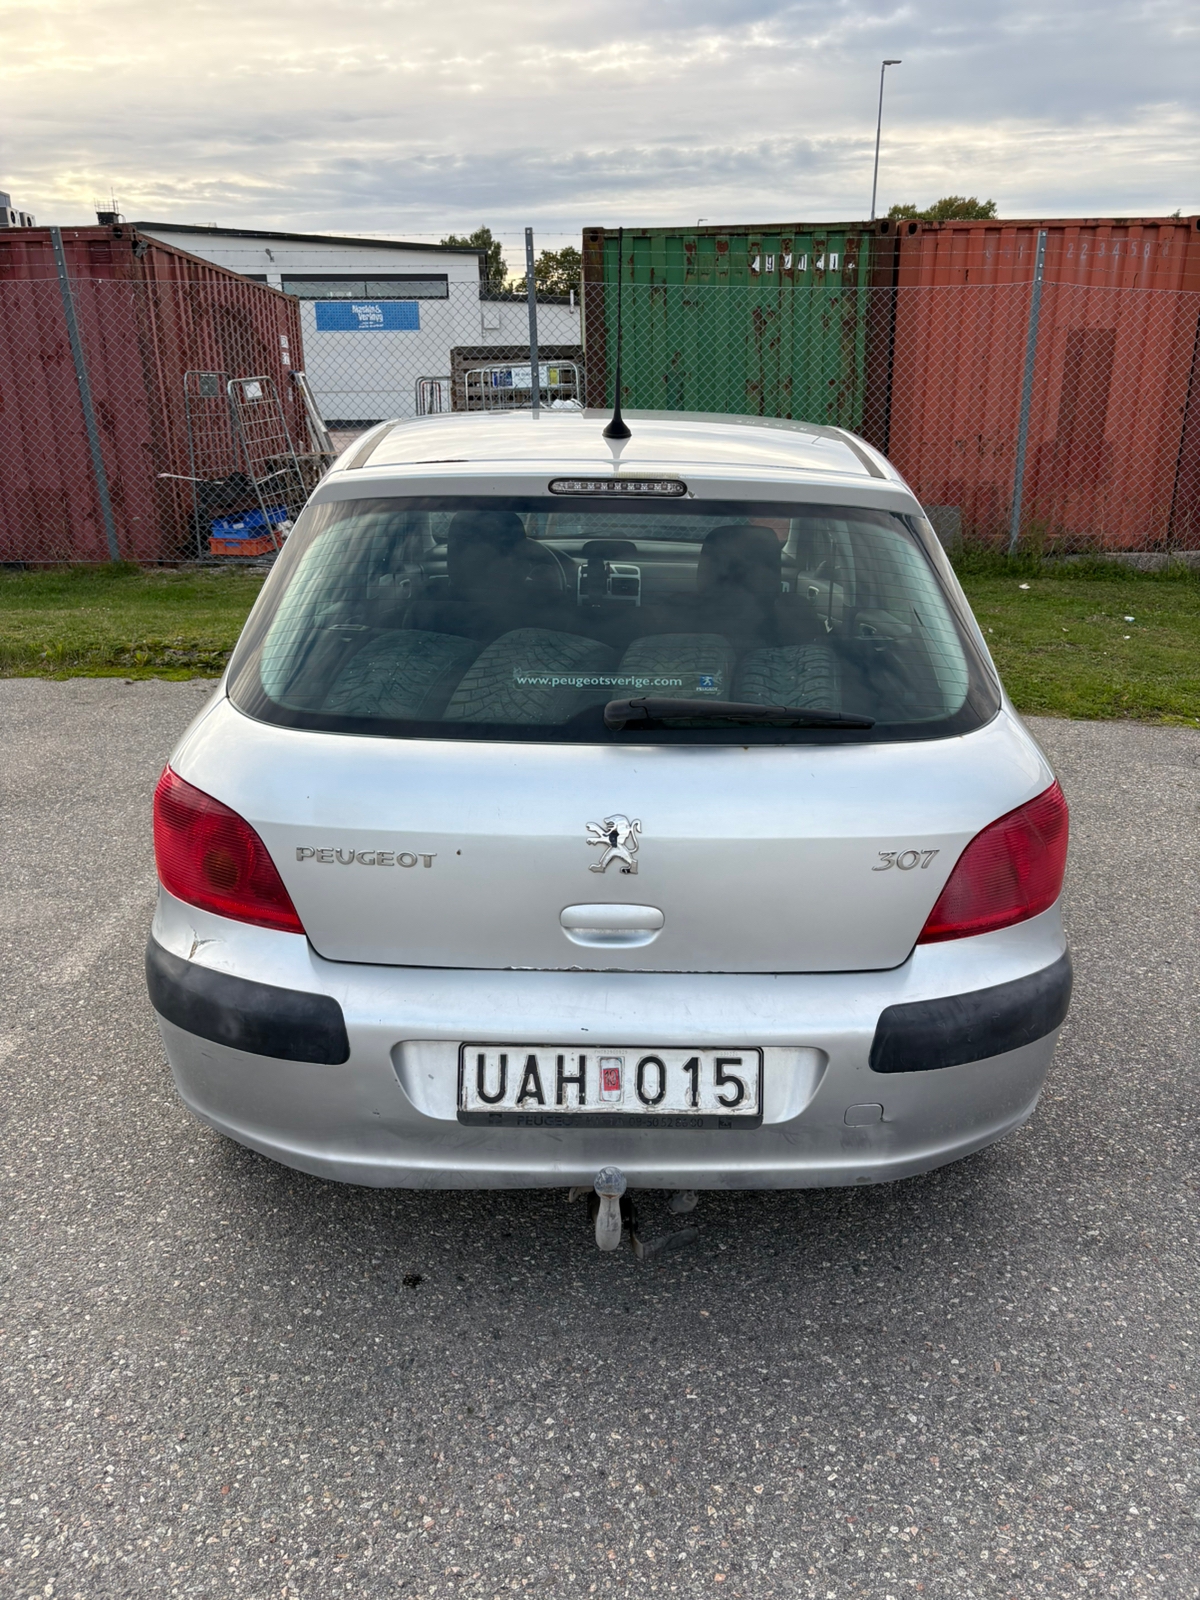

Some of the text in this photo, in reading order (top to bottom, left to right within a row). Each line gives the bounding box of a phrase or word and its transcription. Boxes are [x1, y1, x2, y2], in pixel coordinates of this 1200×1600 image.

[516, 675, 683, 688] www.peugeotsverige.com
[295, 845, 438, 869] PEUGEOT
[871, 848, 941, 871] 307
[476, 1053, 745, 1108] UAH 015
[516, 1115, 580, 1127] PEUGEOT
